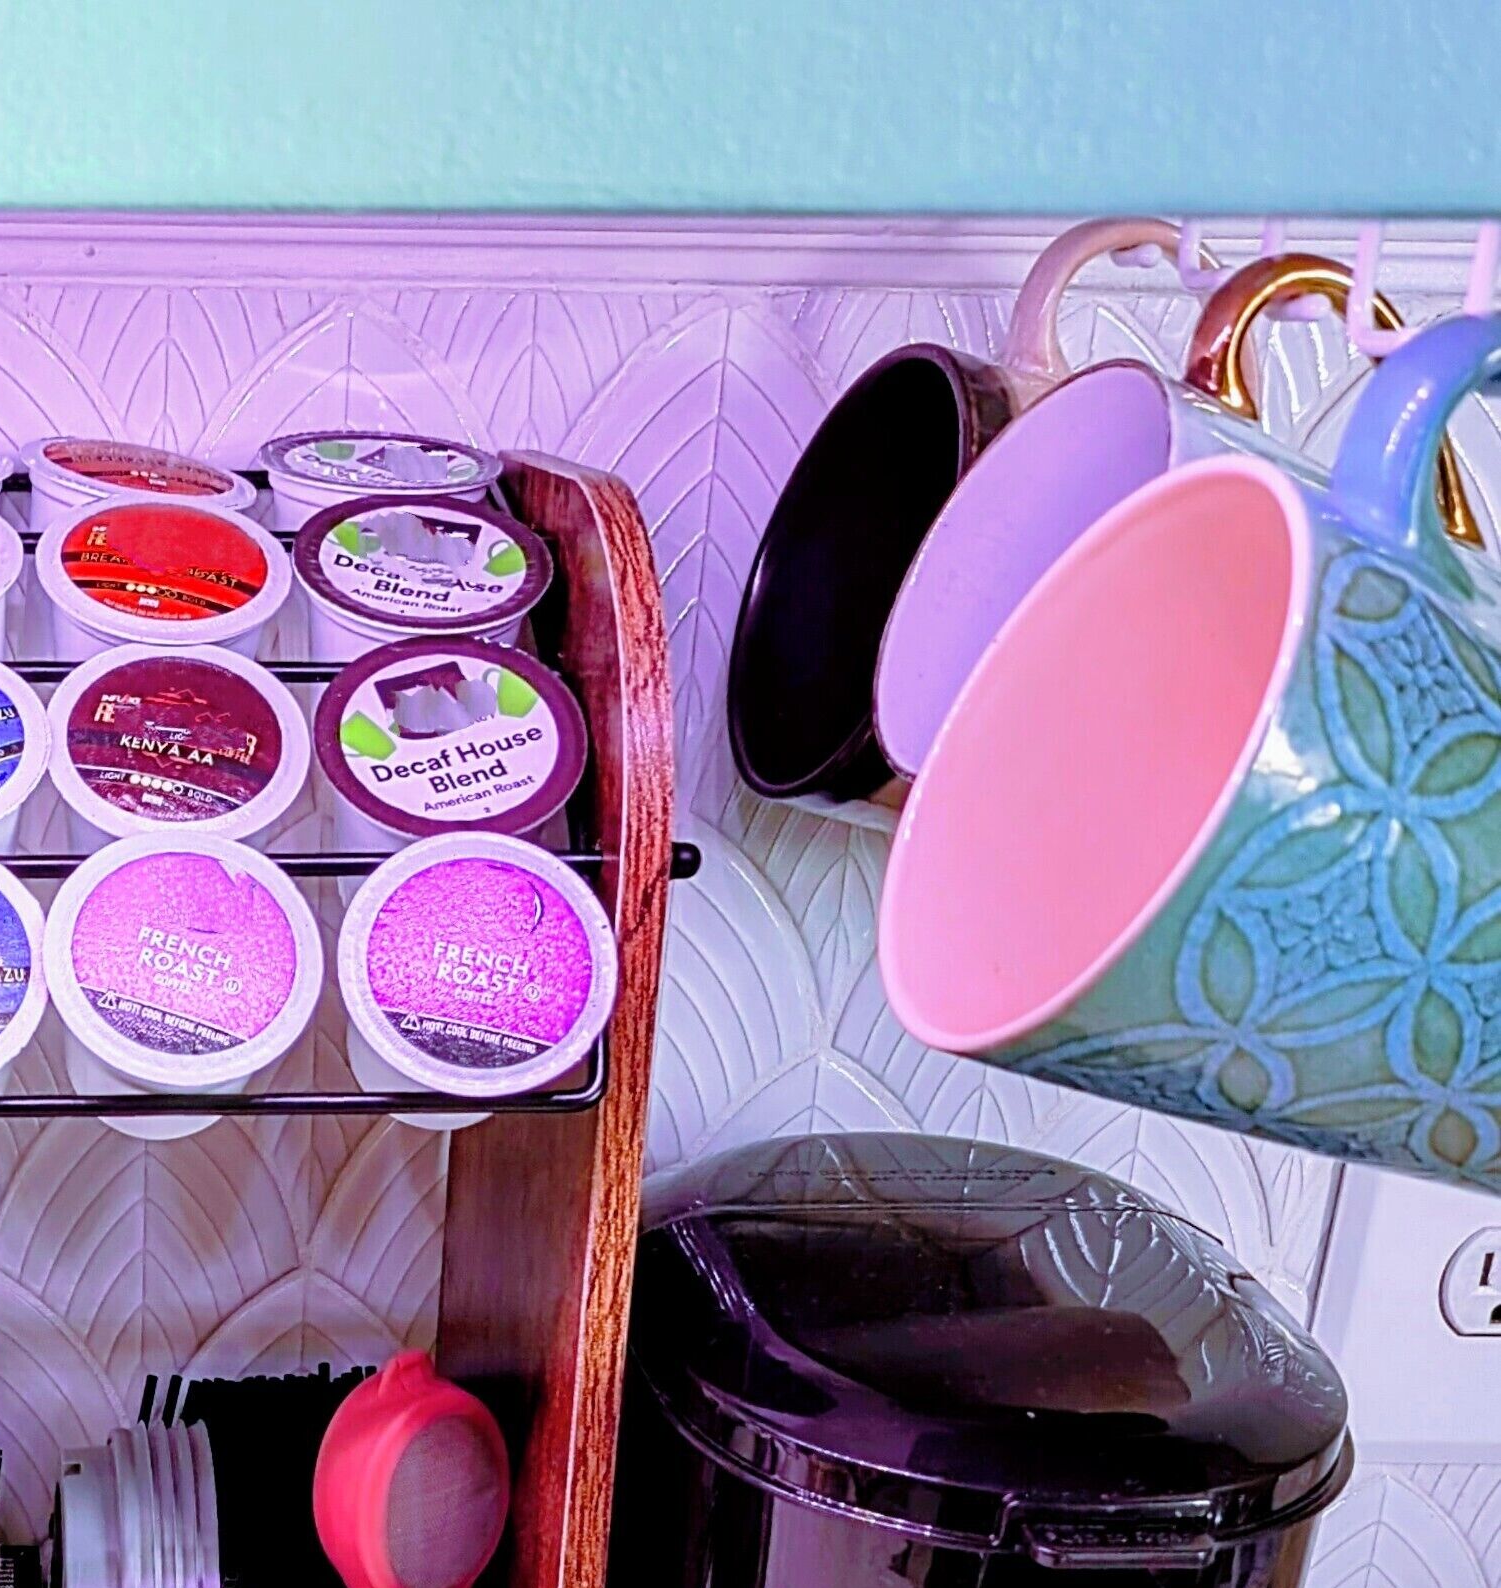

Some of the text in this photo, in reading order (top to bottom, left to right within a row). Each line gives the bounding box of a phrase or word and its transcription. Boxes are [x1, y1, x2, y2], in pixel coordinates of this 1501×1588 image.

[349, 587, 420, 608] American
[372, 578, 450, 602] Blend
[120, 734, 214, 766] KENYA AA
[370, 727, 543, 783] Decaf House
[424, 775, 536, 812] American Roast
[428, 759, 508, 794] Blend
[137, 926, 233, 971] FRENCH
[138, 947, 220, 986] ROAST
[433, 941, 530, 978] FRENCH
[436, 964, 520, 995] ROAST
